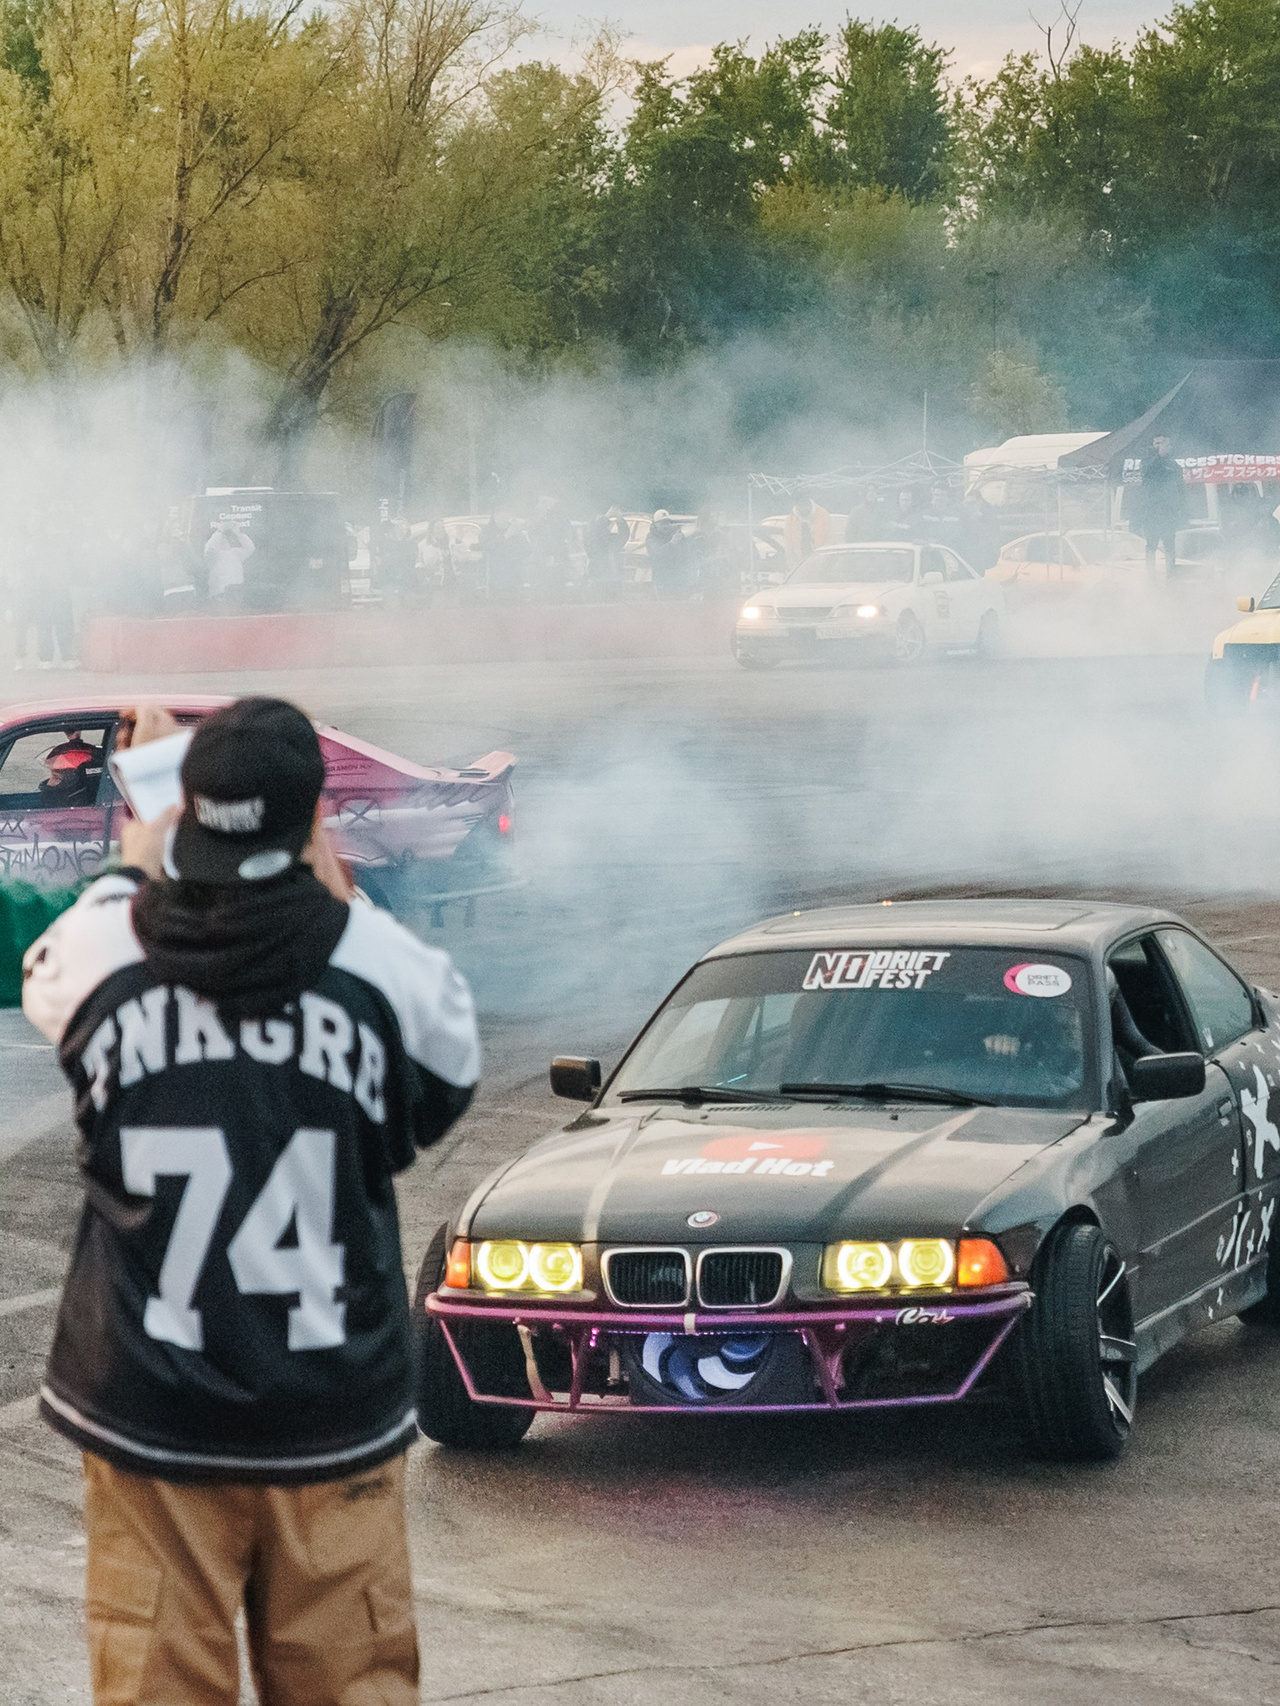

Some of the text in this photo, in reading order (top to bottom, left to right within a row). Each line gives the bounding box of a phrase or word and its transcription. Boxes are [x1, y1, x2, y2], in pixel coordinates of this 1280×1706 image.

[871, 951, 951, 970] DRIFT
[863, 969, 932, 989] FEST
[660, 1157, 835, 1177] Vlad Hot
[119, 1131, 346, 1351] 74
